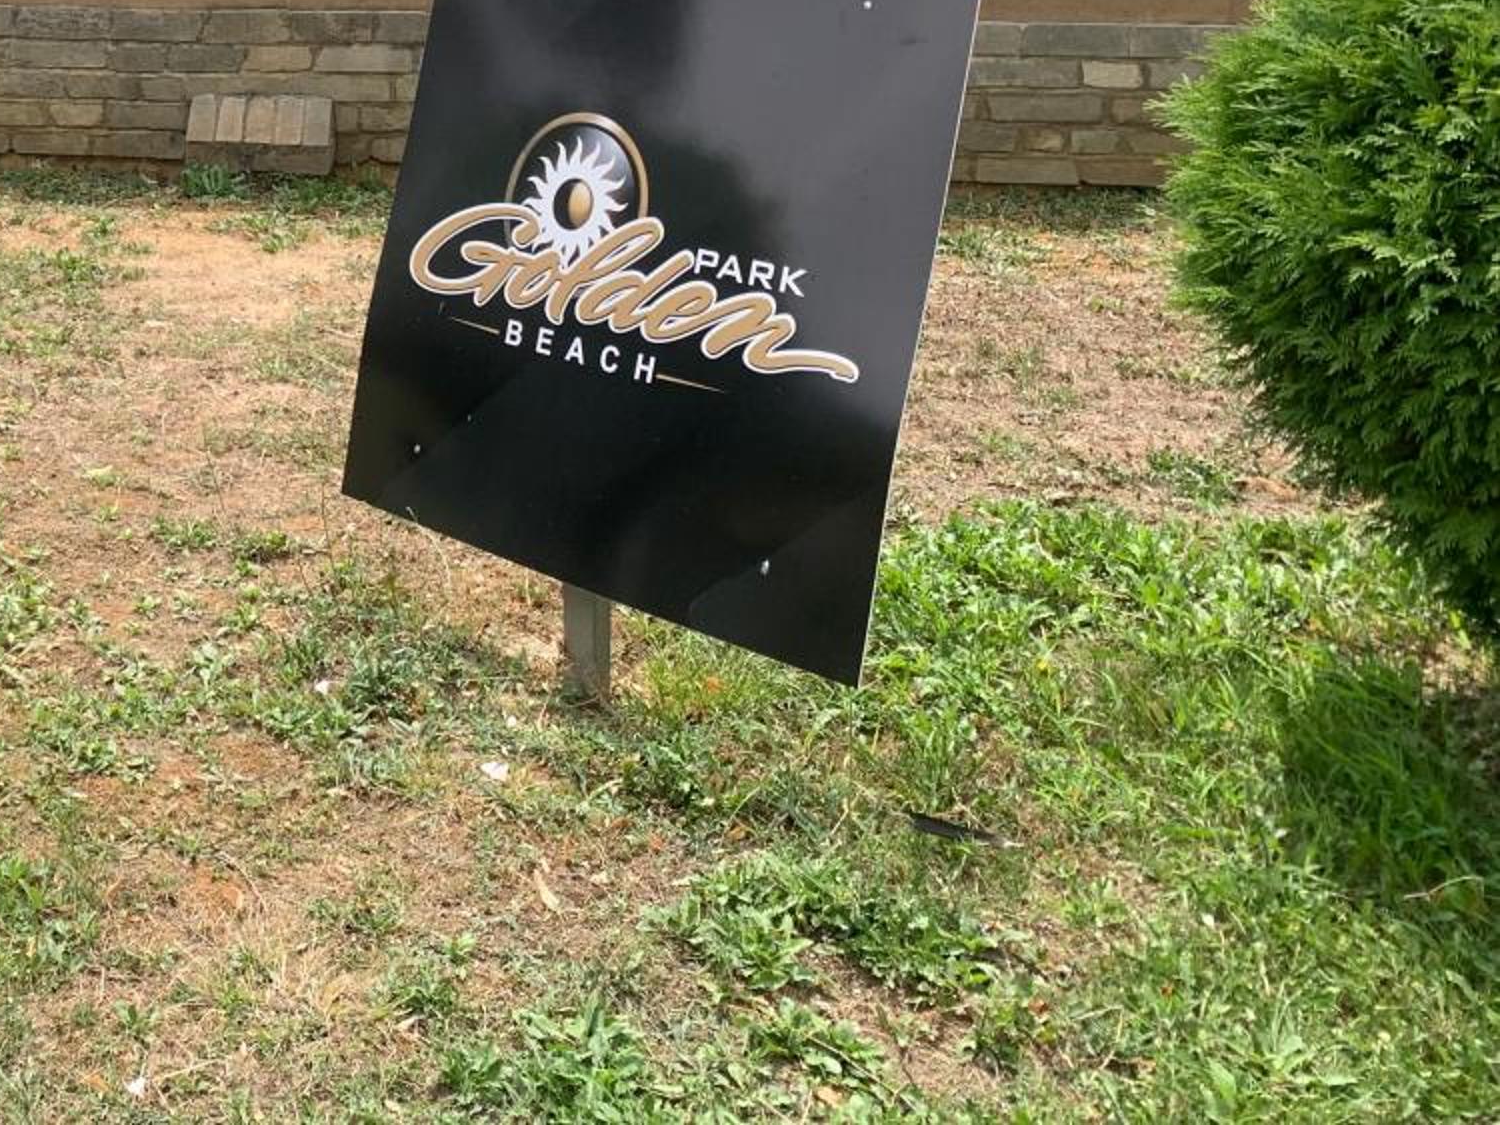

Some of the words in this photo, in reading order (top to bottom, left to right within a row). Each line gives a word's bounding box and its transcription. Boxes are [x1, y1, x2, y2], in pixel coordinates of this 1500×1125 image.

[409, 202, 859, 383] Golden
[693, 248, 807, 298] PARK
[504, 319, 656, 384] BEACH
